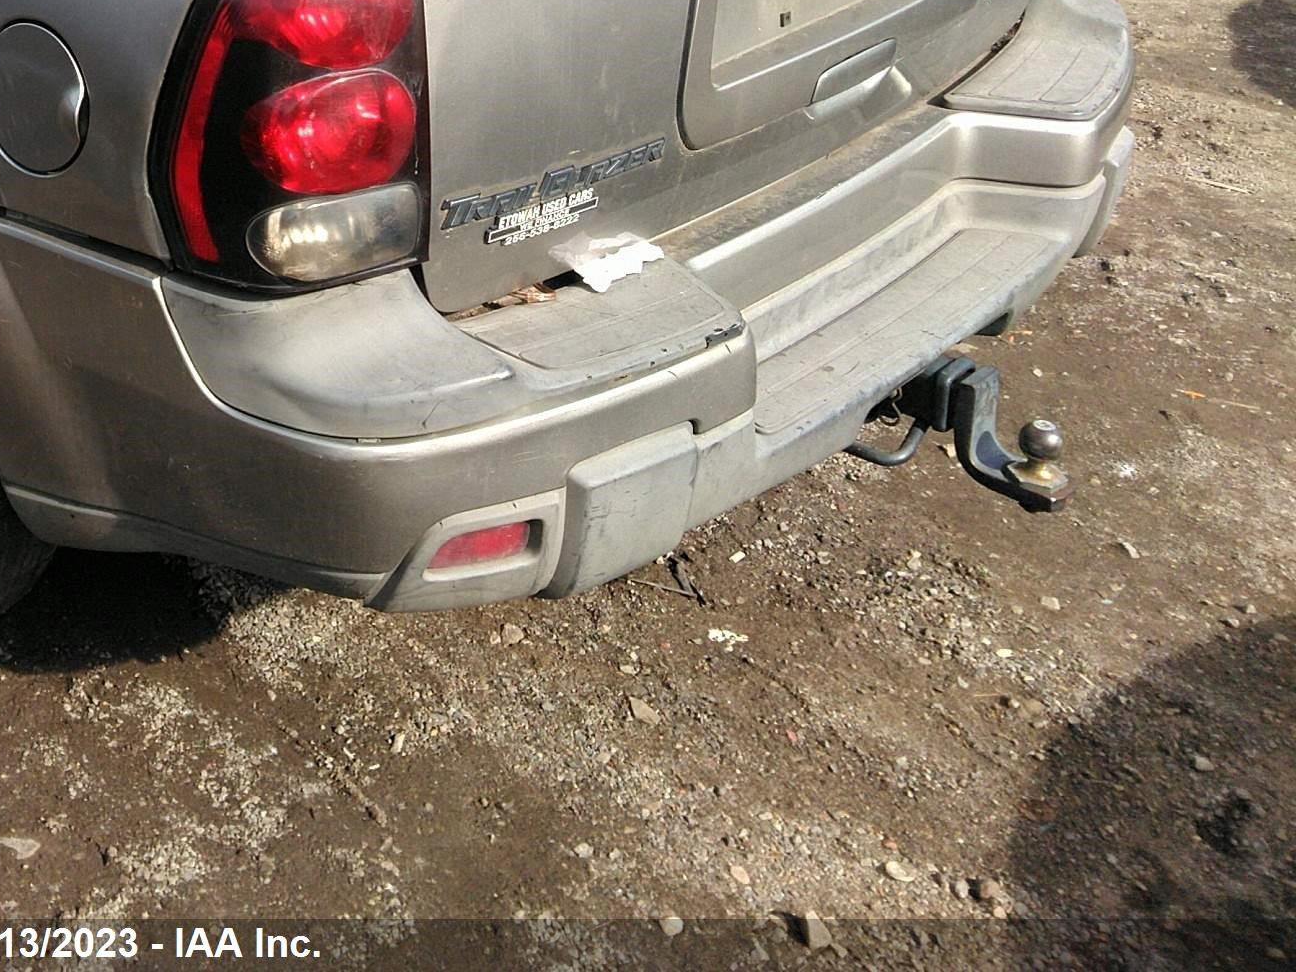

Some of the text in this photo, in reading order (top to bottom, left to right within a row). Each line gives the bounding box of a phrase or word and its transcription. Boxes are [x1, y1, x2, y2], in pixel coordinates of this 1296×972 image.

[497, 187, 594, 230] ETOWAH USED CARS
